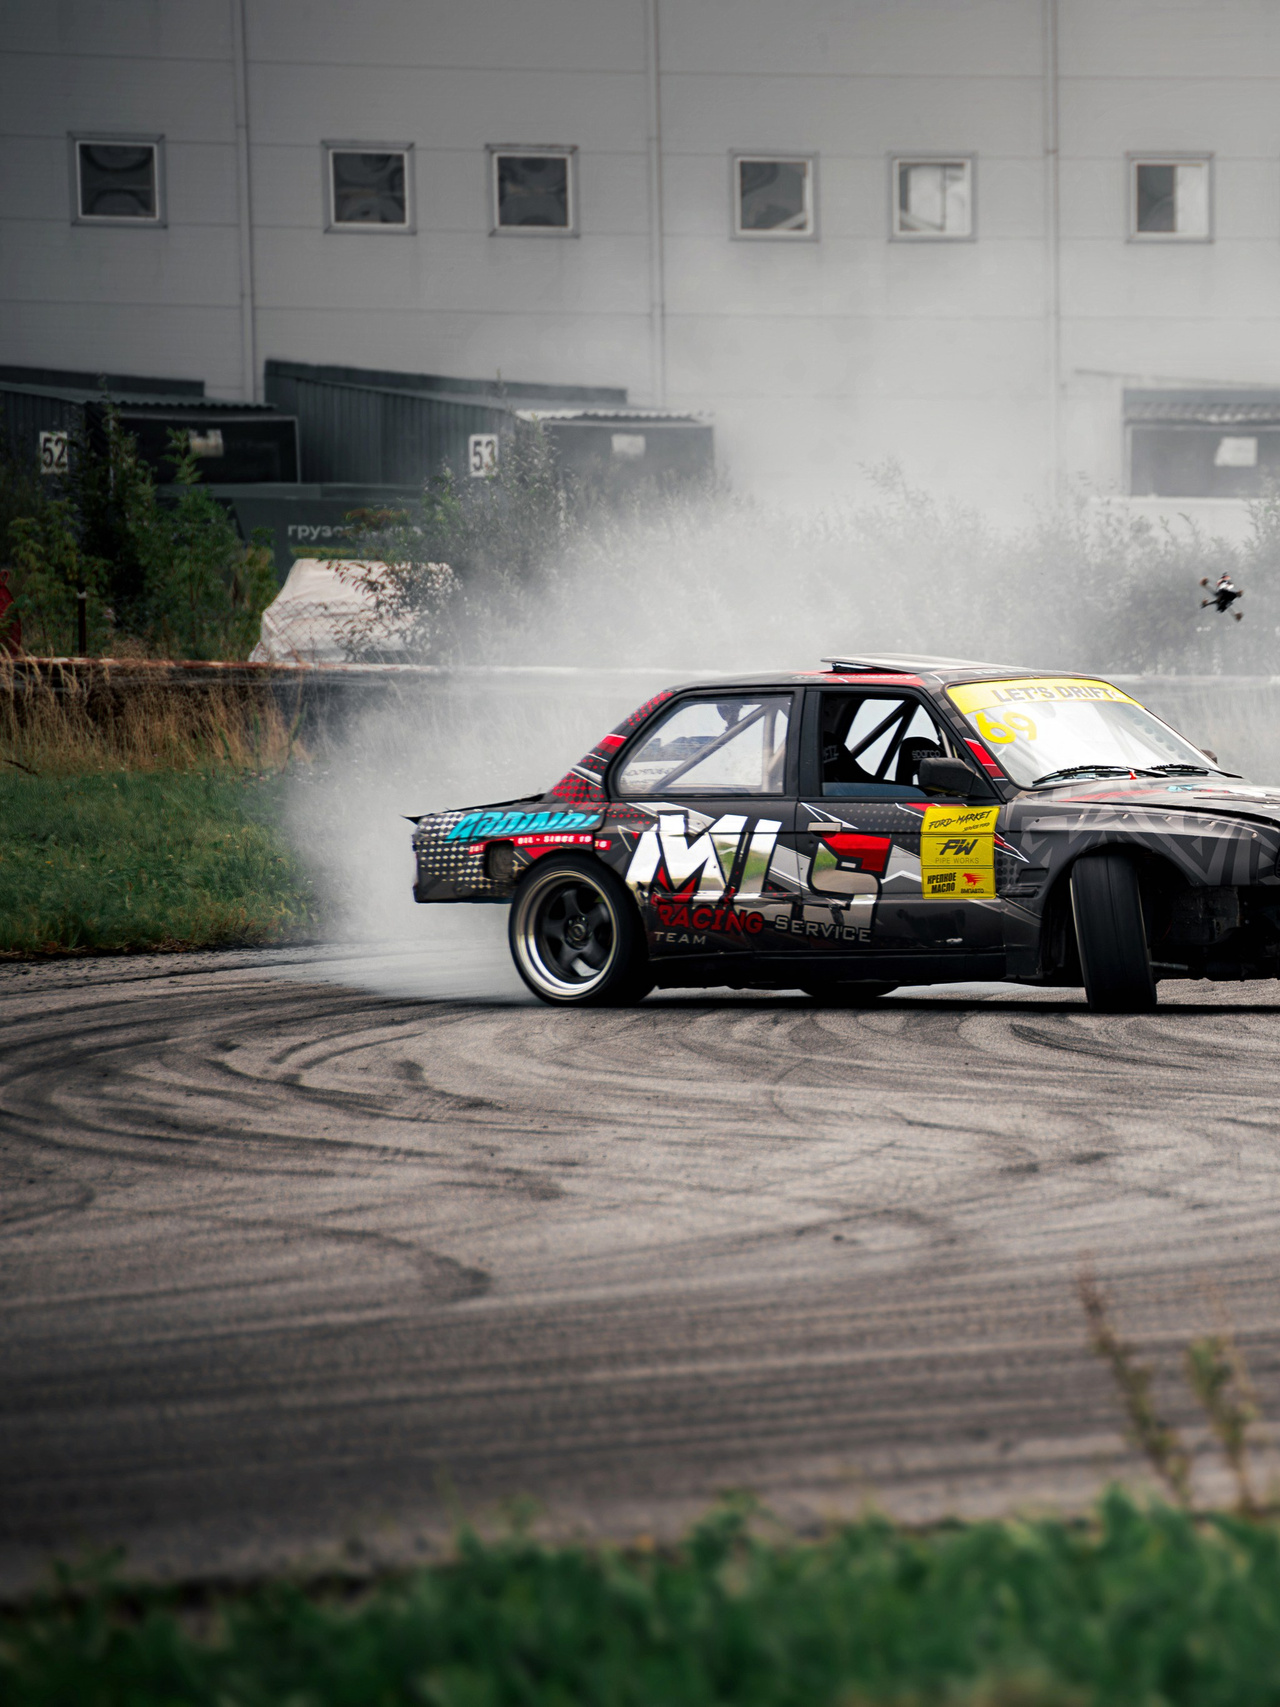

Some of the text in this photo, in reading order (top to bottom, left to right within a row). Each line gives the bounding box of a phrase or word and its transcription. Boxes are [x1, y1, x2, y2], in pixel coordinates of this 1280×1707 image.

[43, 437, 67, 467] 52
[473, 440, 495, 472] 53
[992, 686, 1055, 702] LET'S
[1054, 685, 1117, 700] DRIFT
[975, 711, 1037, 744] 69
[931, 883, 956, 894] МАСЛО
[654, 931, 707, 945] TEAM
[657, 904, 872, 943] RACING SERVICE
